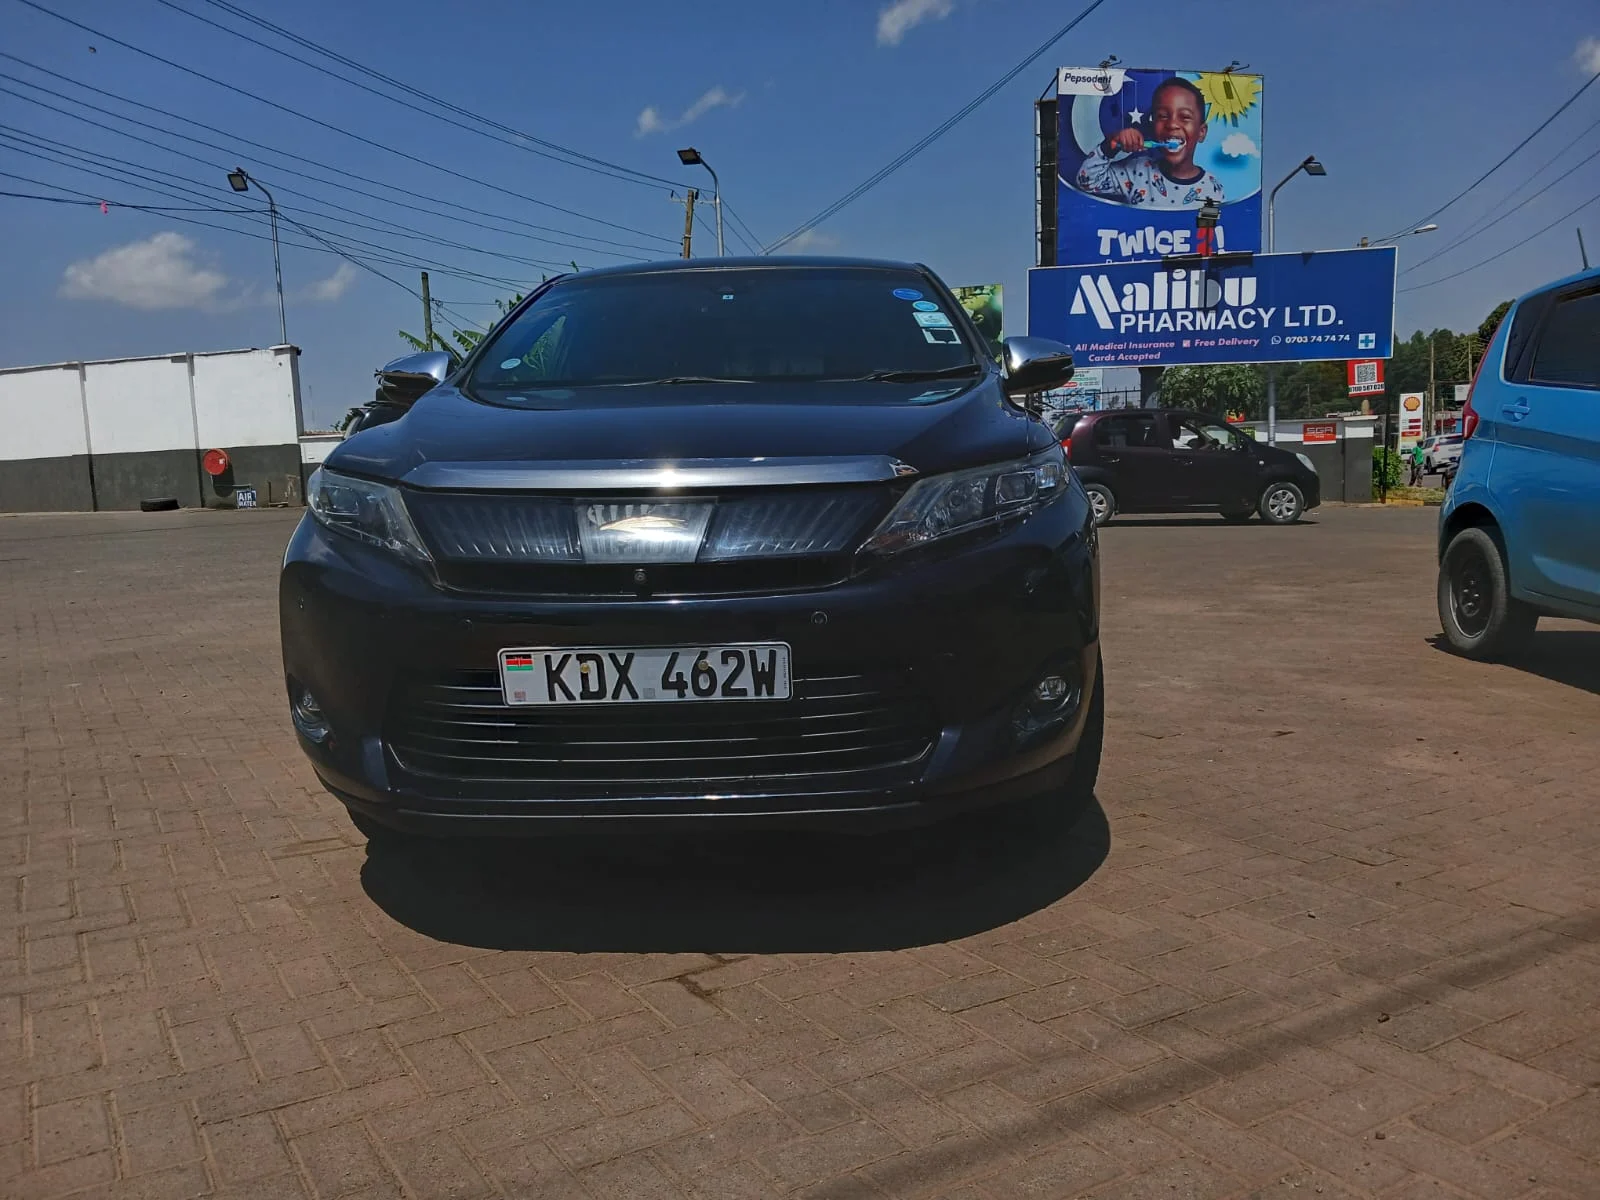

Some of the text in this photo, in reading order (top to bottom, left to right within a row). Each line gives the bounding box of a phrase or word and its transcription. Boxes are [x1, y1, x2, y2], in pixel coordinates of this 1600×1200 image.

[1070, 268, 1257, 329] Malibu
[1120, 304, 1344, 333] PHARMACY LTD.
[1194, 338, 1260, 347] Free Delivery
[1285, 335, 1308, 344] 0703
[1324, 334, 1336, 342] 74
[1075, 341, 1175, 351] All Medical Insurance
[1088, 352, 1161, 362] Cards Accepted
[239, 492, 252, 501] AIR
[544, 652, 639, 700] KDX
[661, 649, 777, 698] 462W
